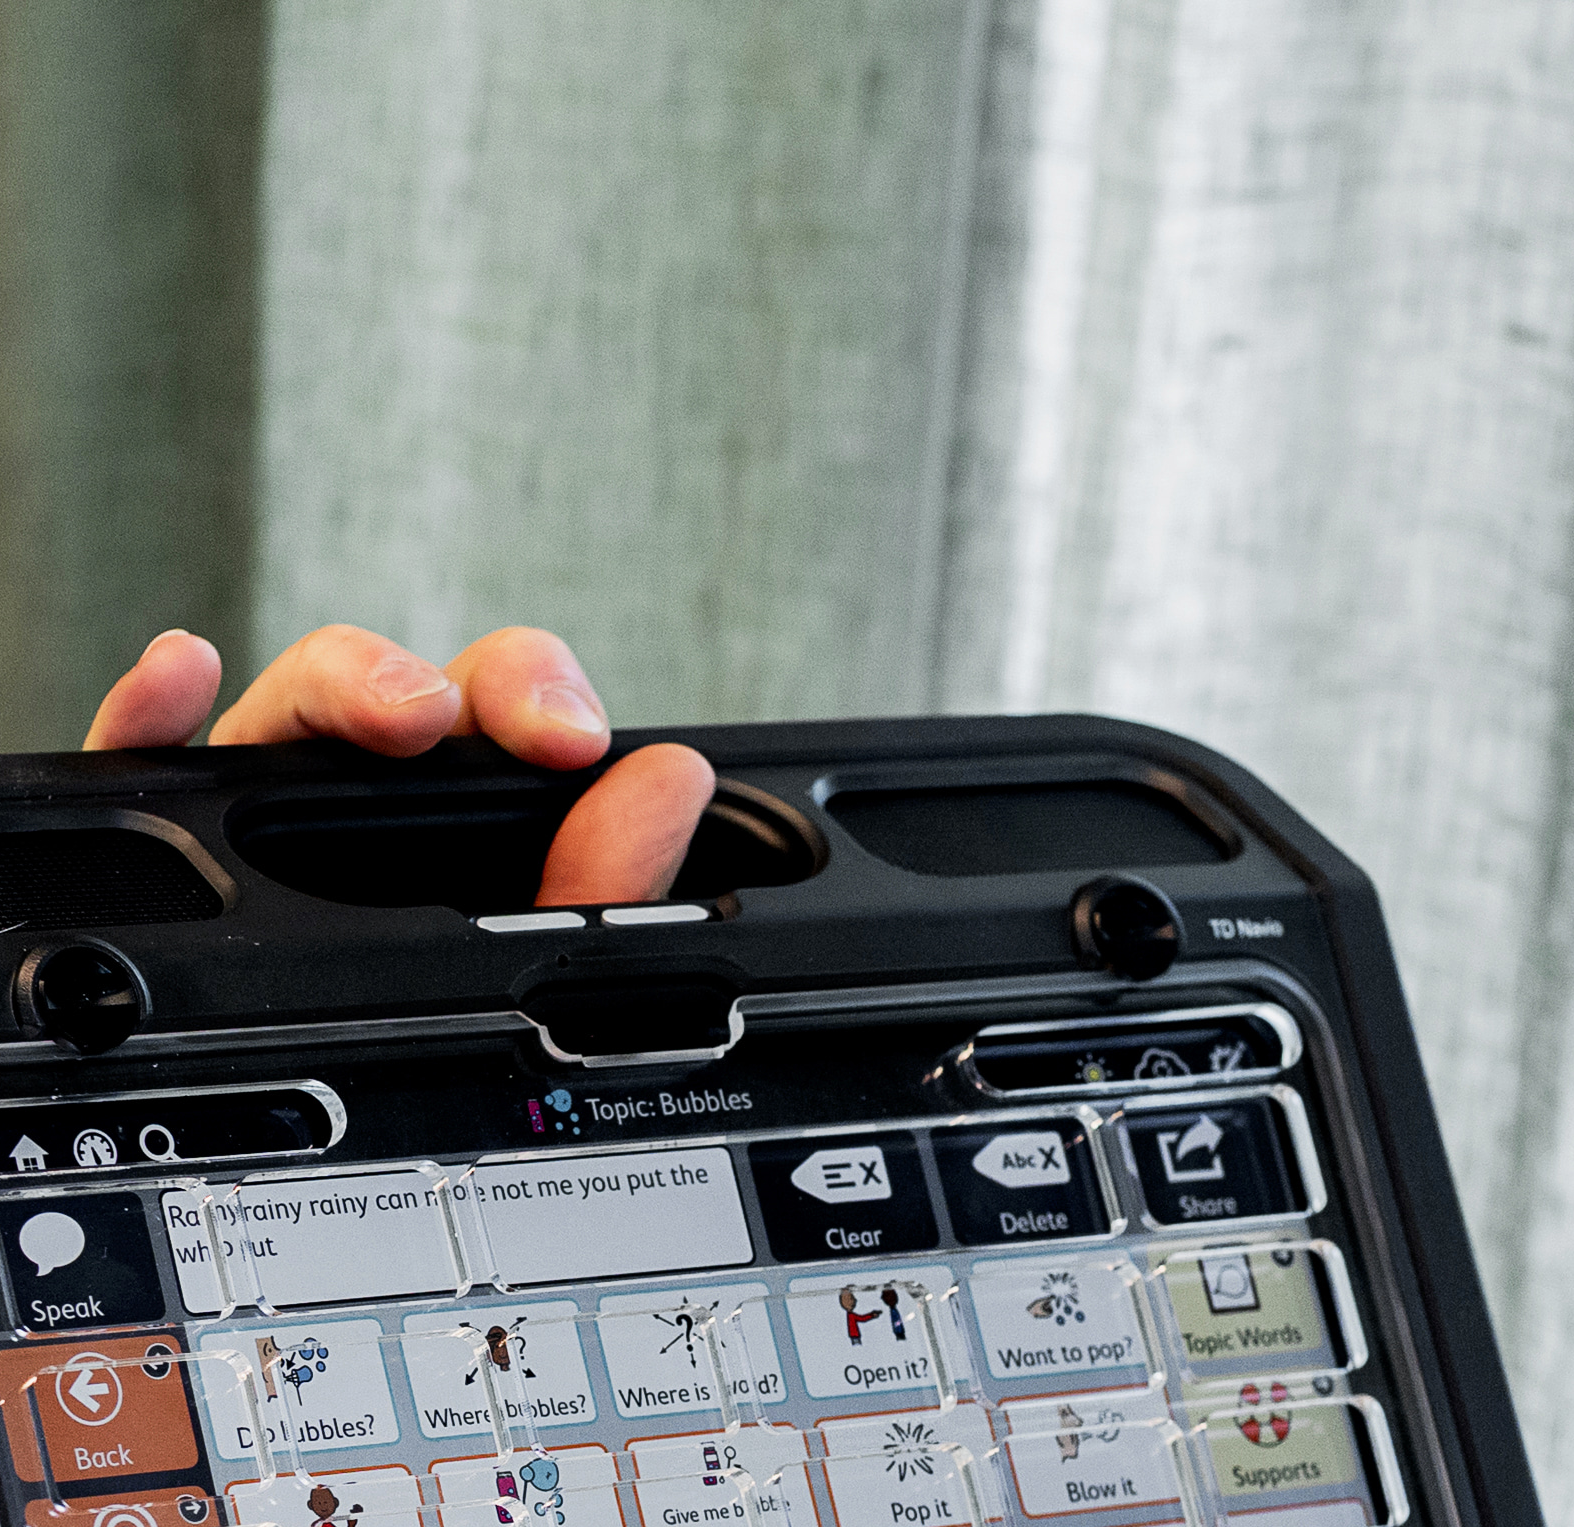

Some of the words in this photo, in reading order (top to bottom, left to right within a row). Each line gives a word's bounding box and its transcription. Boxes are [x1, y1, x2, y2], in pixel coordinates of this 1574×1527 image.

[584, 1097, 656, 1126] Topic:
[659, 1088, 753, 1116] Bubbles
[168, 1203, 237, 1228] Rany
[243, 1198, 302, 1225] rainy
[310, 1192, 368, 1218] rainy
[374, 1190, 418, 1211] can
[492, 1179, 533, 1201] not
[537, 1177, 574, 1198] me
[578, 1173, 621, 1200] you
[627, 1167, 666, 1196] put
[670, 1163, 709, 1187] the
[1178, 1194, 1237, 1219] Share
[999, 1210, 1069, 1235] Delete
[825, 1227, 883, 1251] Clear
[31, 1294, 105, 1329] Speak
[997, 1346, 1057, 1370] Want
[1061, 1344, 1083, 1364] to
[1088, 1336, 1133, 1366] pop?
[1183, 1330, 1234, 1356] Topic
[1237, 1322, 1303, 1348] Words
[843, 1363, 901, 1389] Open
[904, 1357, 929, 1382] it?
[619, 1383, 691, 1410] Where
[693, 1382, 711, 1401] is
[74, 1442, 134, 1471] Back
[1231, 1459, 1323, 1489] Supports
[1065, 1479, 1119, 1503] Blow
[1120, 1477, 1137, 1497] it
[662, 1508, 699, 1526] Give
[703, 1505, 730, 1522] me
[890, 1501, 931, 1526] Pop
[934, 1498, 952, 1519] it
